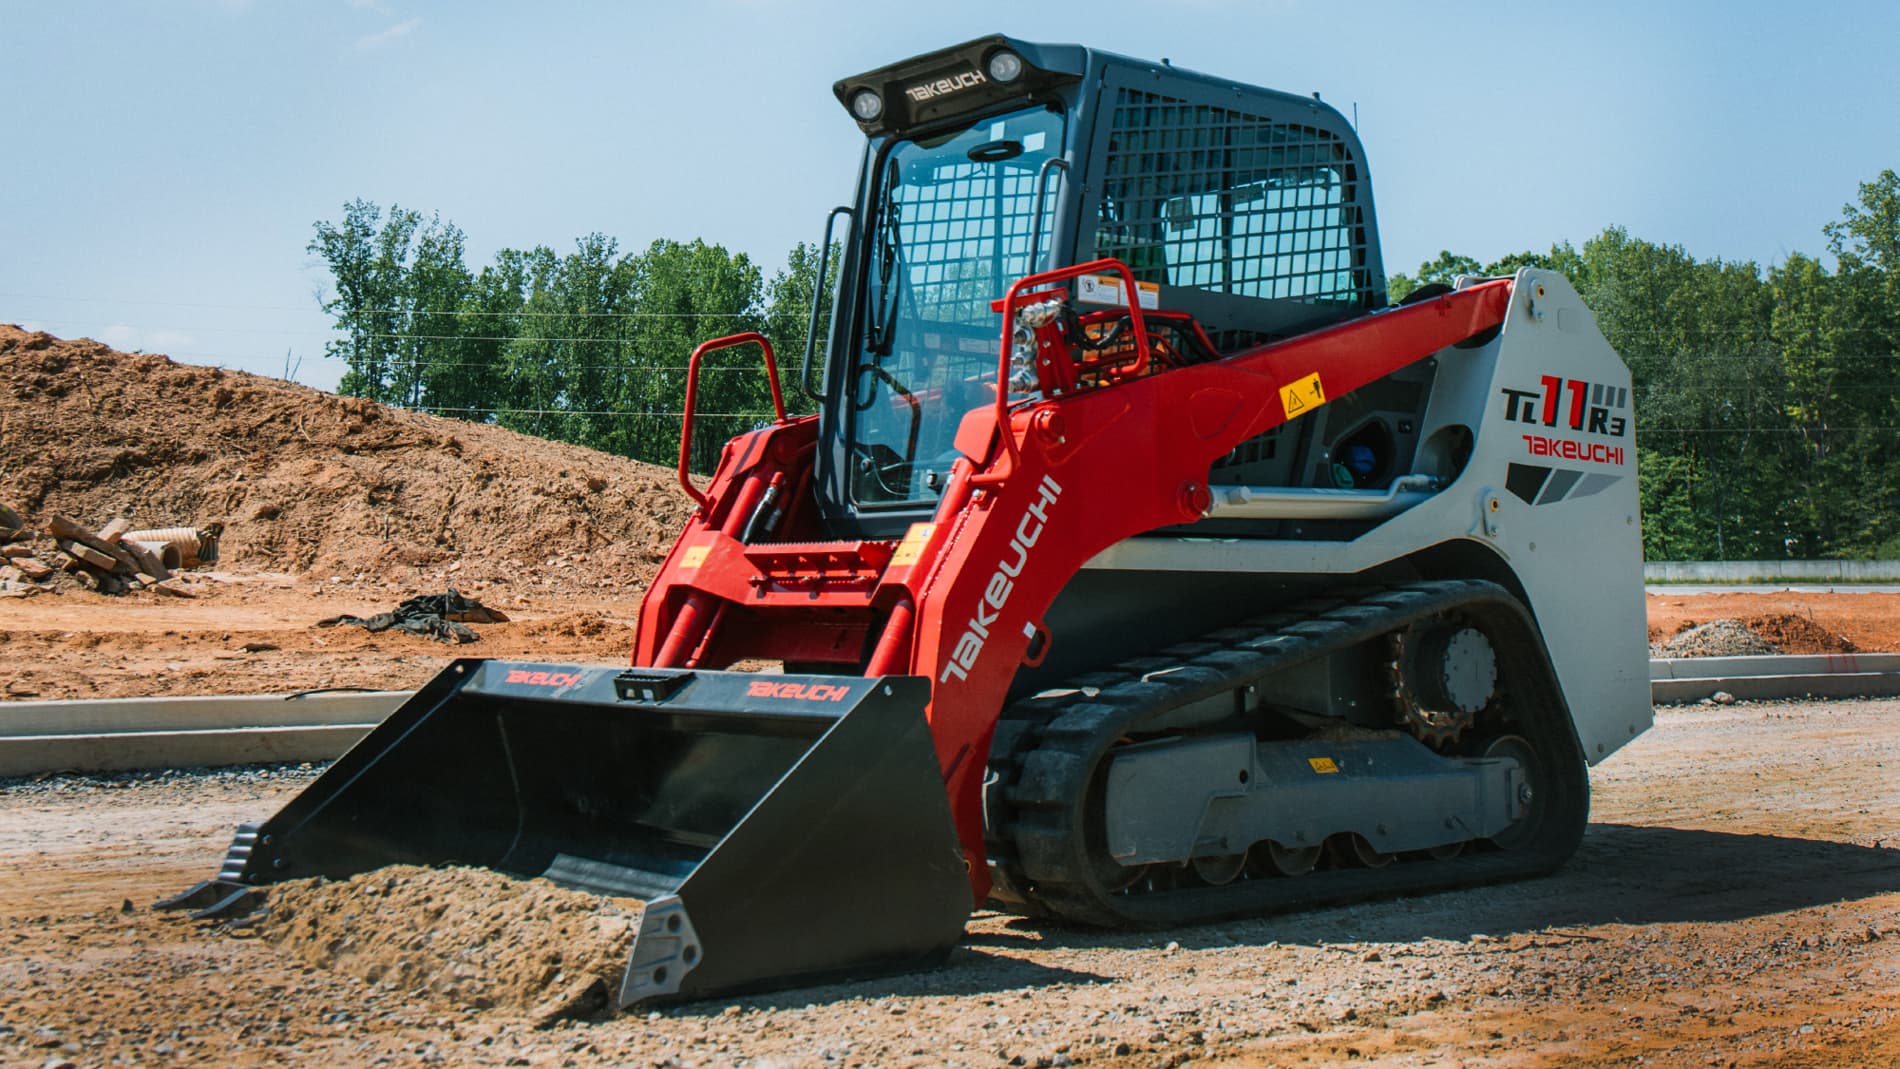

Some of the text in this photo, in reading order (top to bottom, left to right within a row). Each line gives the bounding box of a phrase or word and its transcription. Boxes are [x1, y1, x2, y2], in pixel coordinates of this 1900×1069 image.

[905, 69, 987, 101] TAKEUCH
[1522, 434, 1624, 465] TAKEUCHI
[939, 474, 1062, 684] TAKEUCHI
[745, 681, 850, 702] TAKEUCHI
